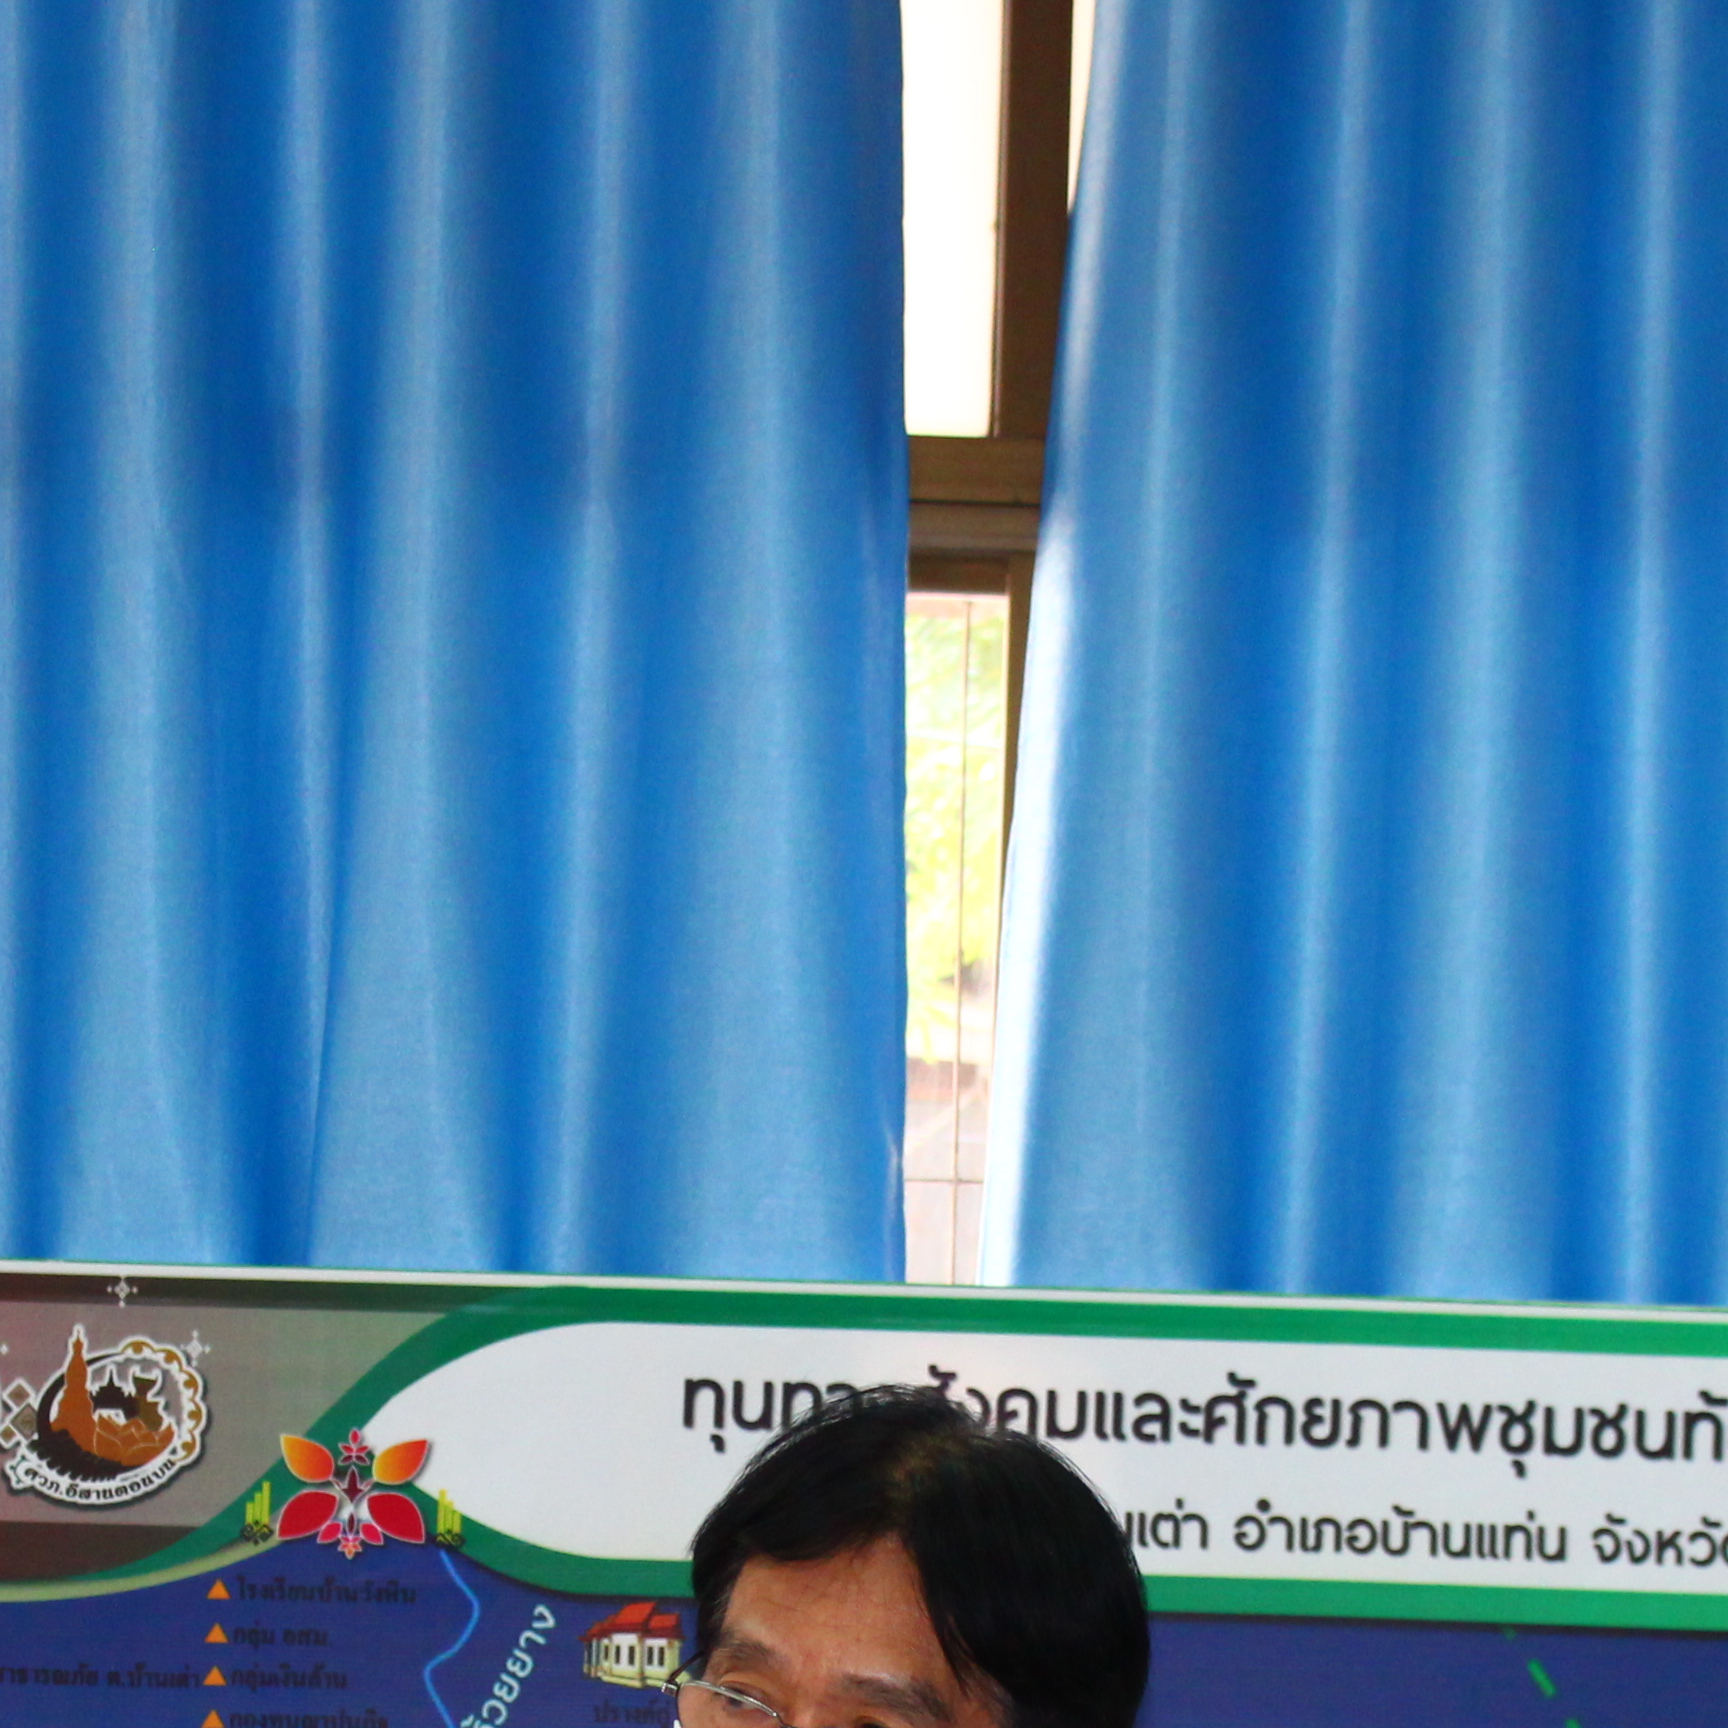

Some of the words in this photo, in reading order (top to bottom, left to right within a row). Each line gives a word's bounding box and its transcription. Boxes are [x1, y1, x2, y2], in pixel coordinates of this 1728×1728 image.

[1233, 1498, 1568, 1563] อำเภอบ้านแท่น
